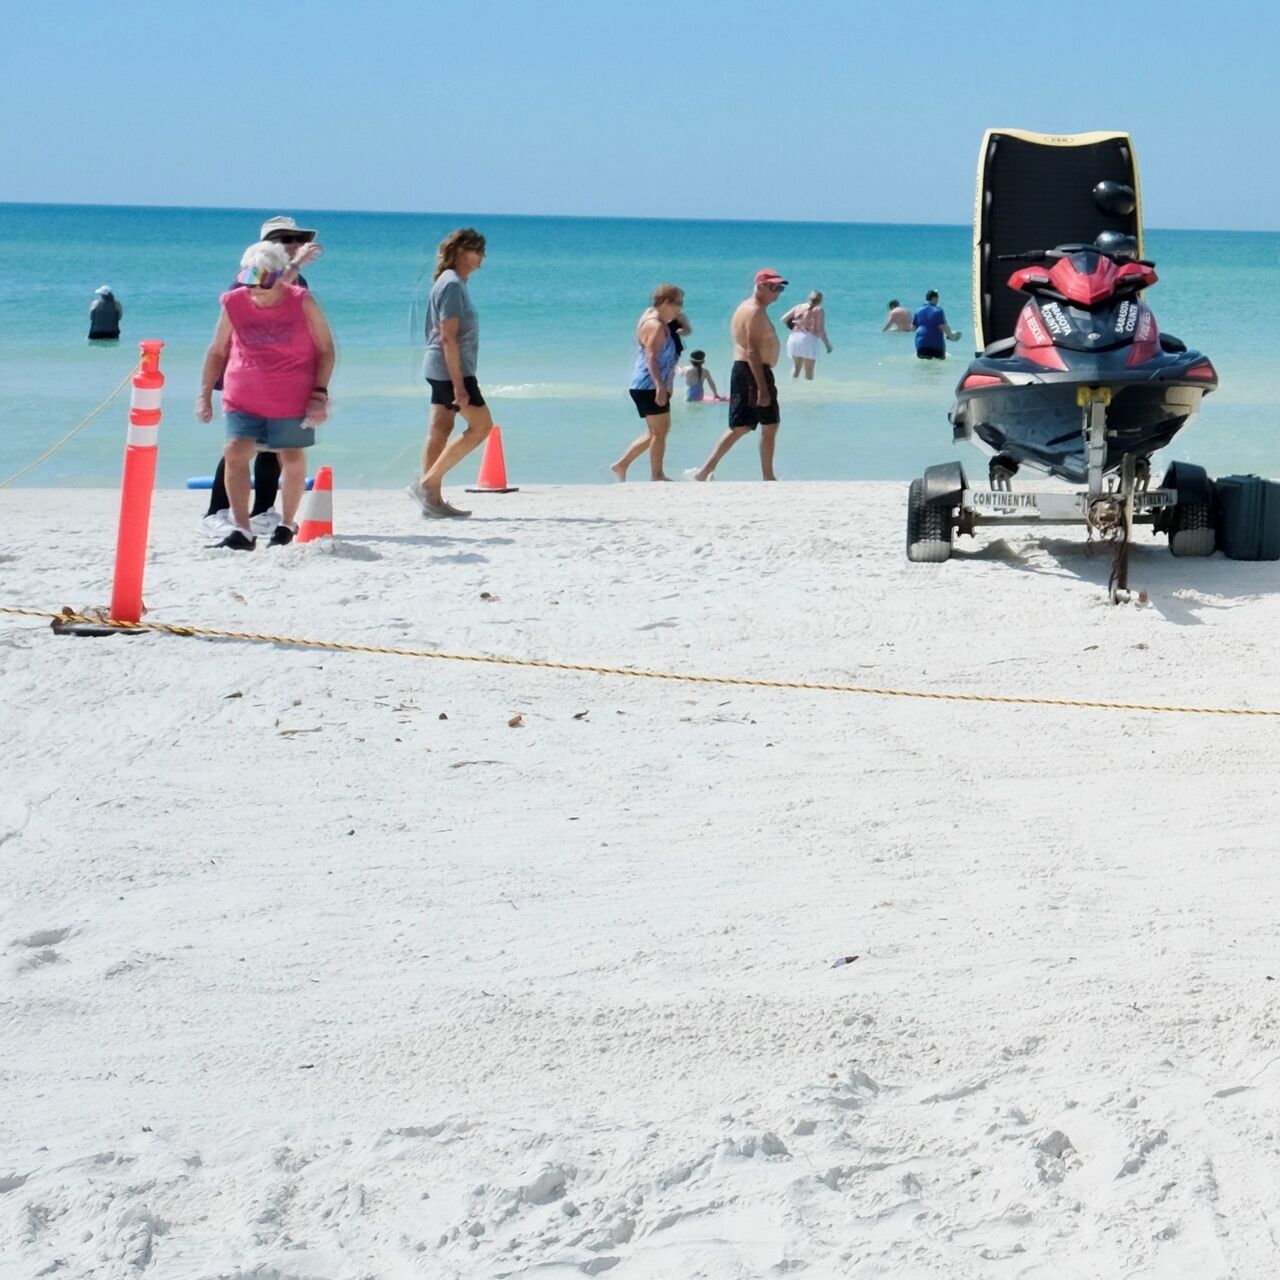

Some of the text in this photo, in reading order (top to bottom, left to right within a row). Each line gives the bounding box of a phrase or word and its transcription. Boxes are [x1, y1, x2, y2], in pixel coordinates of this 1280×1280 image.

[1115, 300, 1129, 333] SARASOTA
[1126, 303, 1138, 332] COUNTY
[973, 493, 1038, 507] CONTINENTAL
